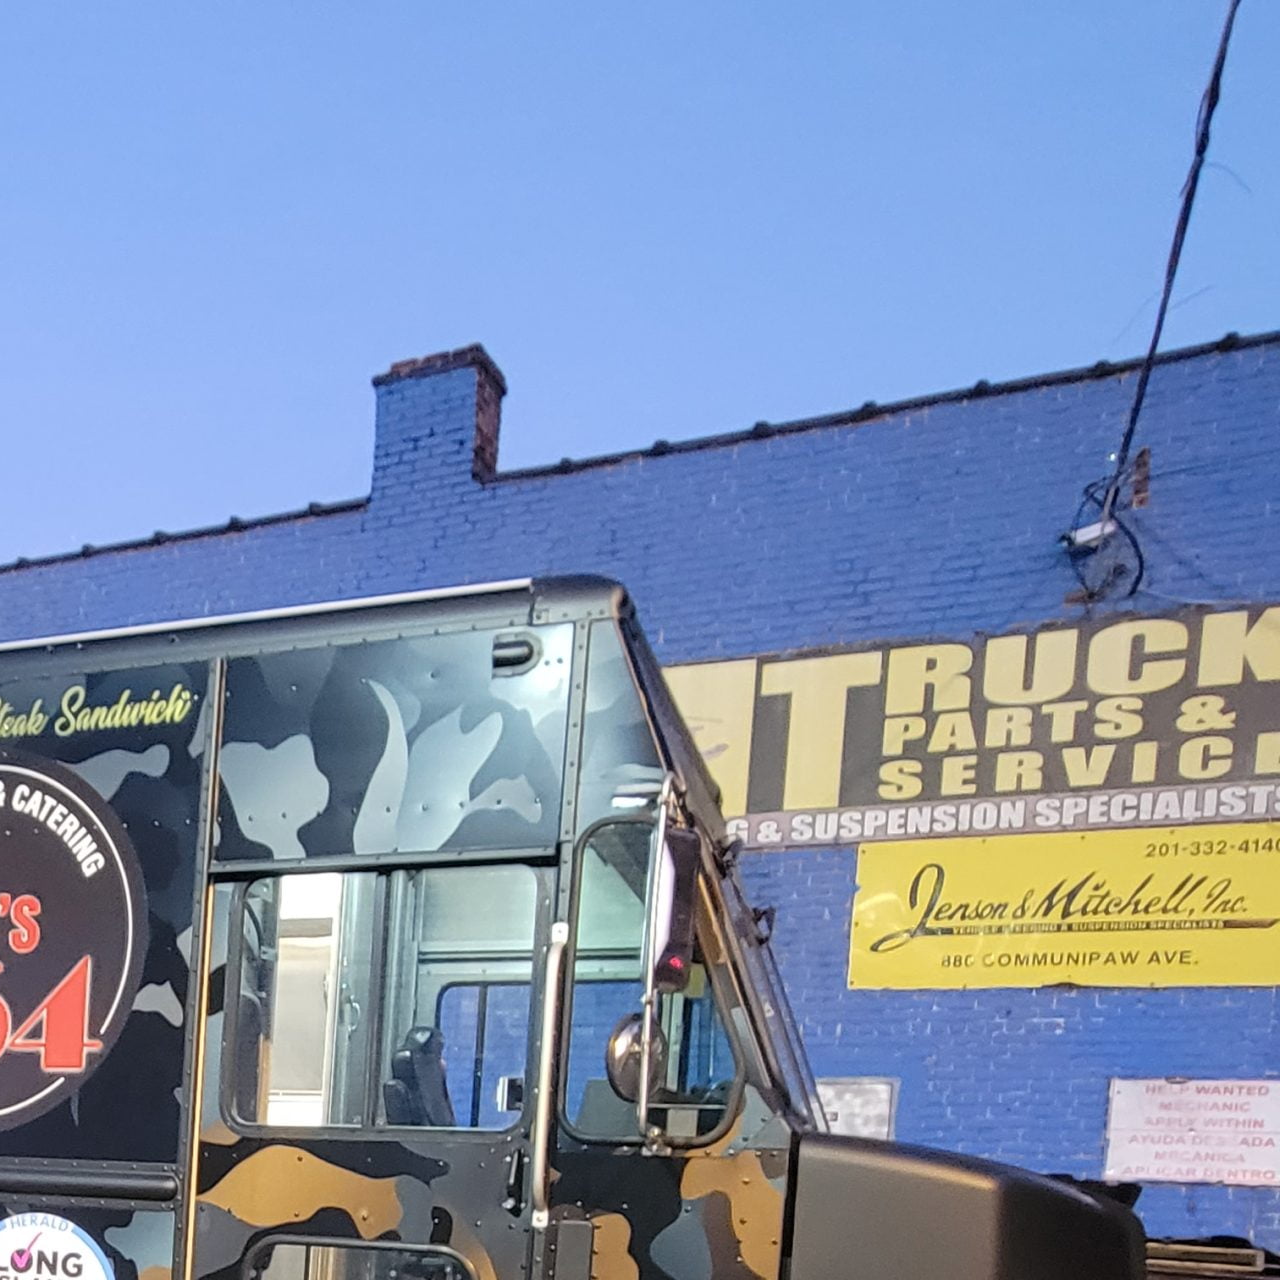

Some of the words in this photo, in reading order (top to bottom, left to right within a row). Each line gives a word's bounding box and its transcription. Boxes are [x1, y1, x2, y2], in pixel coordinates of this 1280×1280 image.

[54, 684, 195, 738] Sandwich
[882, 695, 1144, 756] PARTS
[1176, 694, 1236, 732] &
[11, 784, 107, 878] CATERING
[756, 819, 783, 844] &
[790, 799, 1027, 842] SUSPENSION
[1034, 786, 1280, 827] SPECIALIST
[870, 863, 1008, 952] Jenson
[1012, 888, 1031, 918] &
[1031, 870, 1207, 921] Mitchell,
[1202, 878, 1249, 914] Inc.
[982, 950, 1140, 968] COMMUNIPAW
[1147, 950, 1199, 966] AVE.
[1195, 1085, 1270, 1097] WANTED
[1128, 1134, 1186, 1146] AYUDA
[1203, 1117, 1265, 1129] WITHIN
[10, 1214, 69, 1232] HERALD
